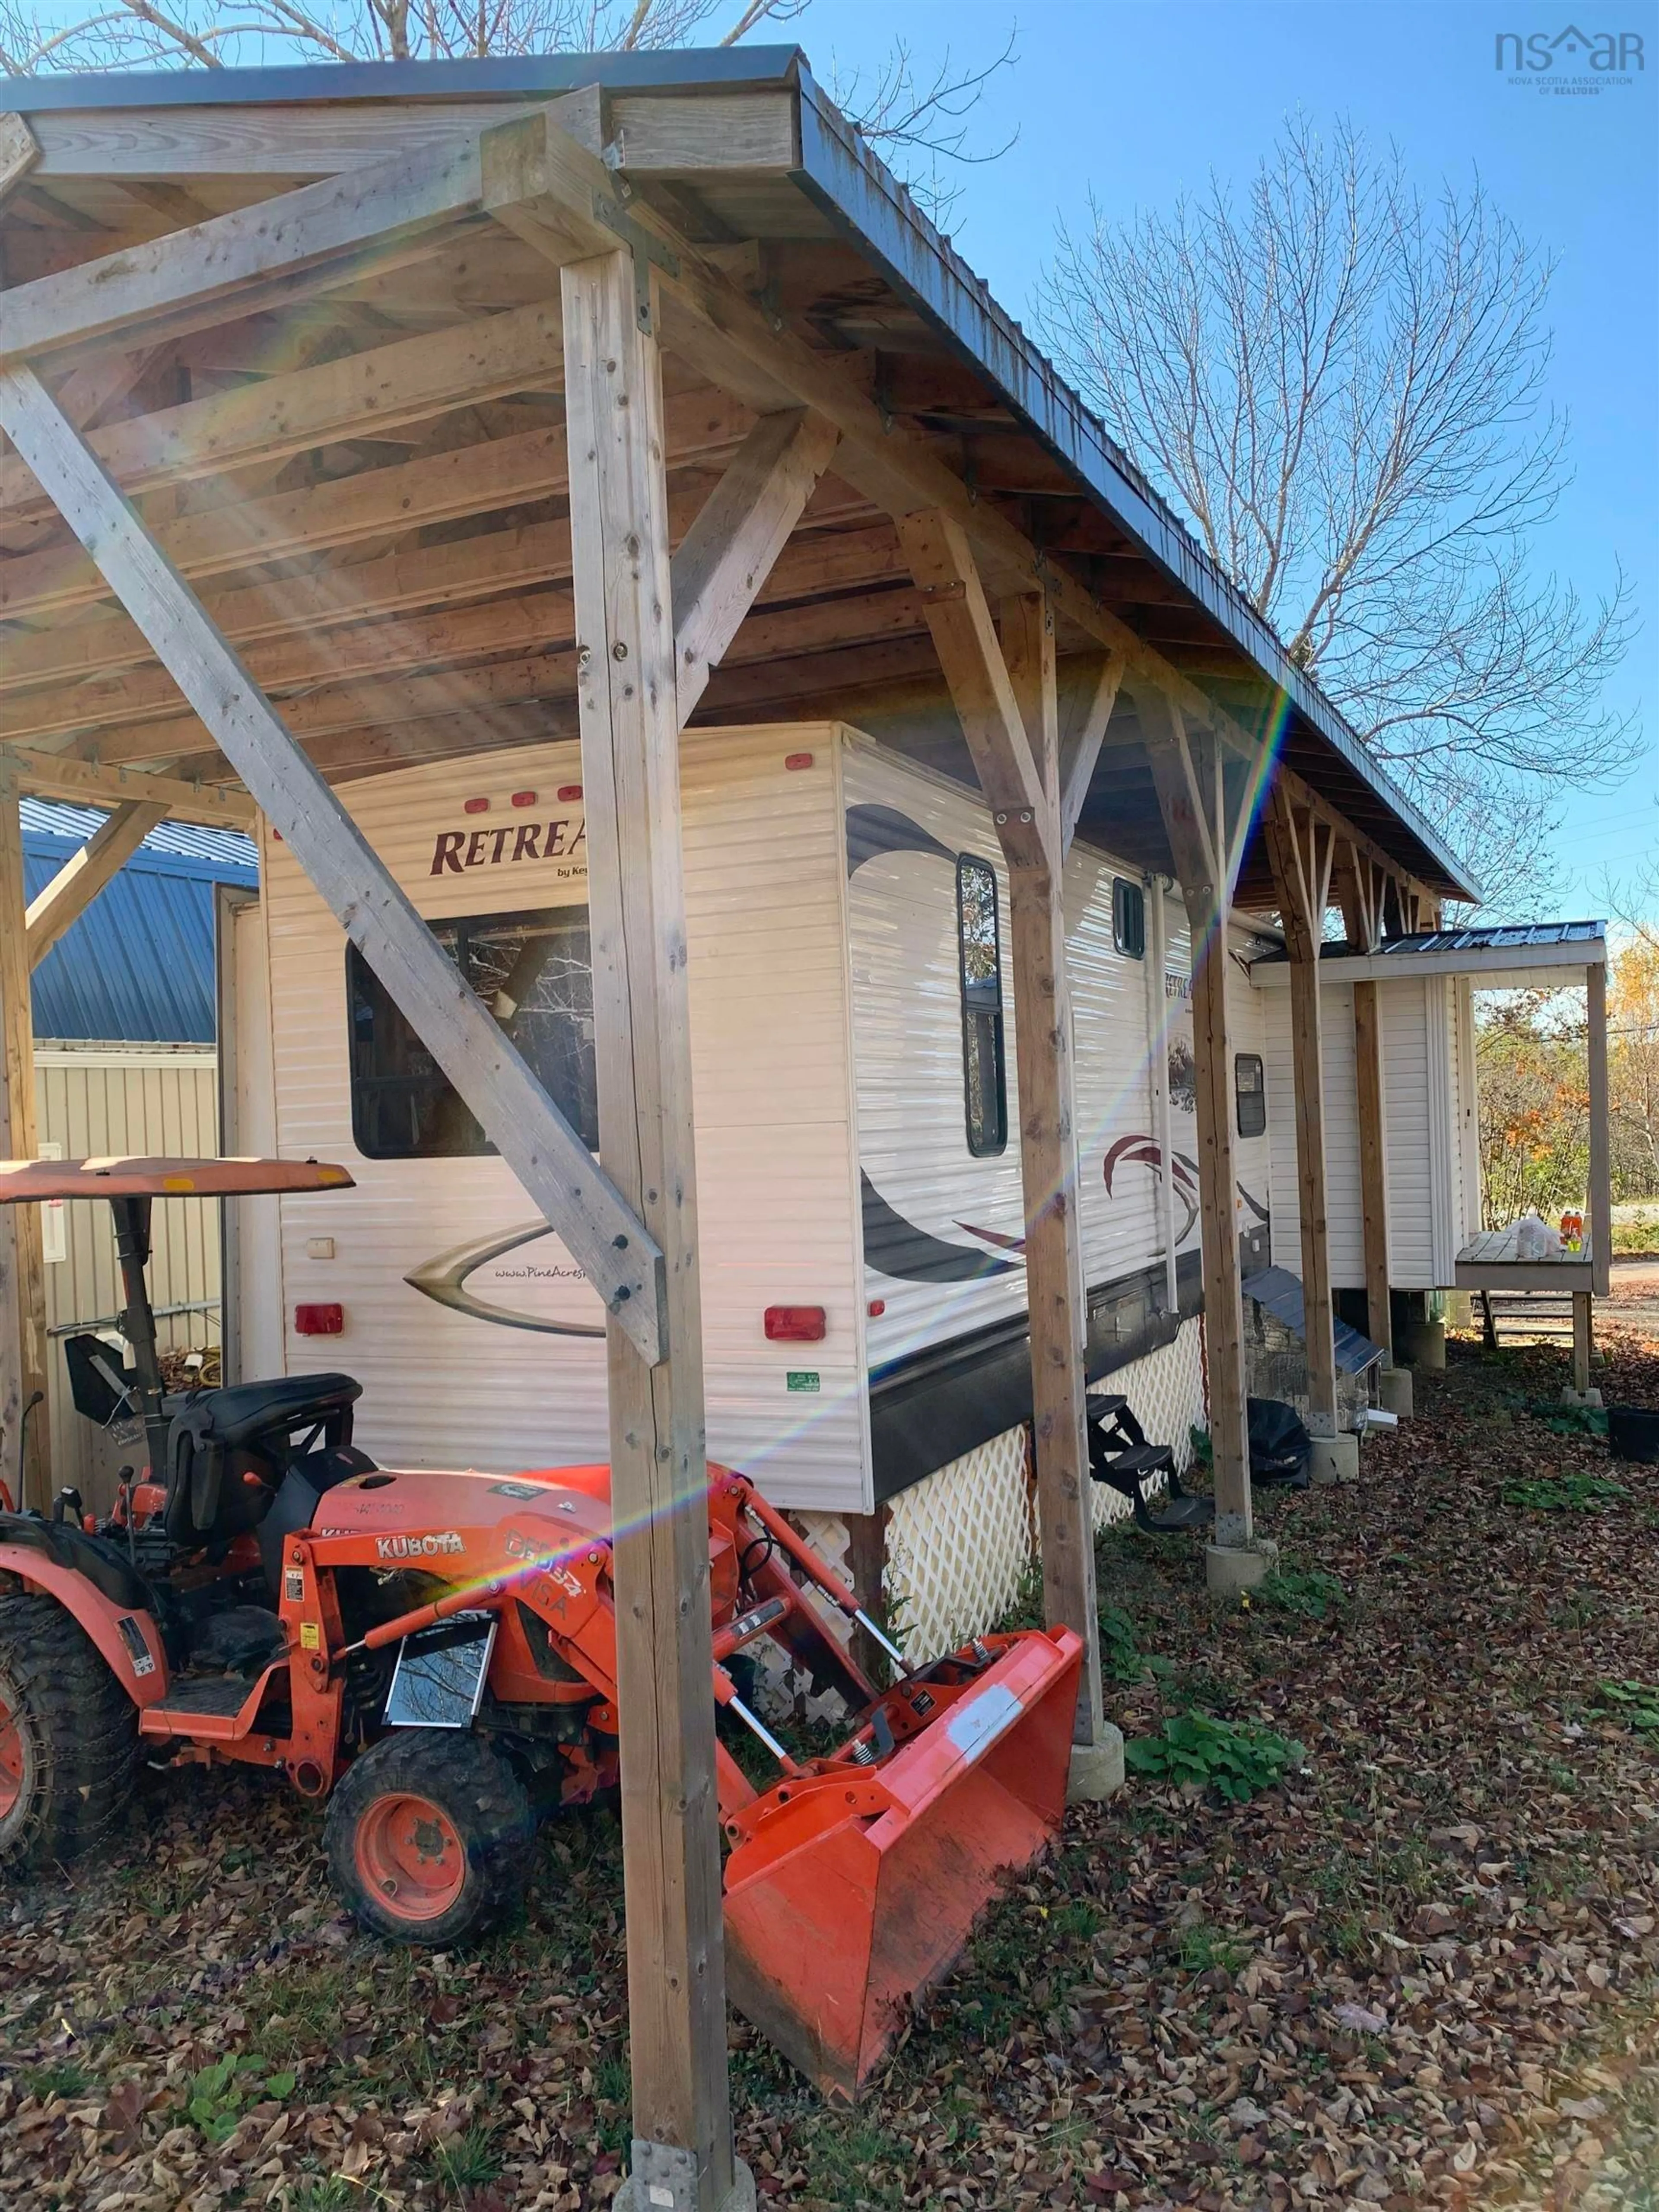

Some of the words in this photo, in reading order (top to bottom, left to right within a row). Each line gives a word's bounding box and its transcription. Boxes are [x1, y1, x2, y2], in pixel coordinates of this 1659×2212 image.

[557, 868, 570, 878] by
[495, 1265, 586, 1280] www.PineAcres
[375, 1531, 466, 1559] KUBOTA
